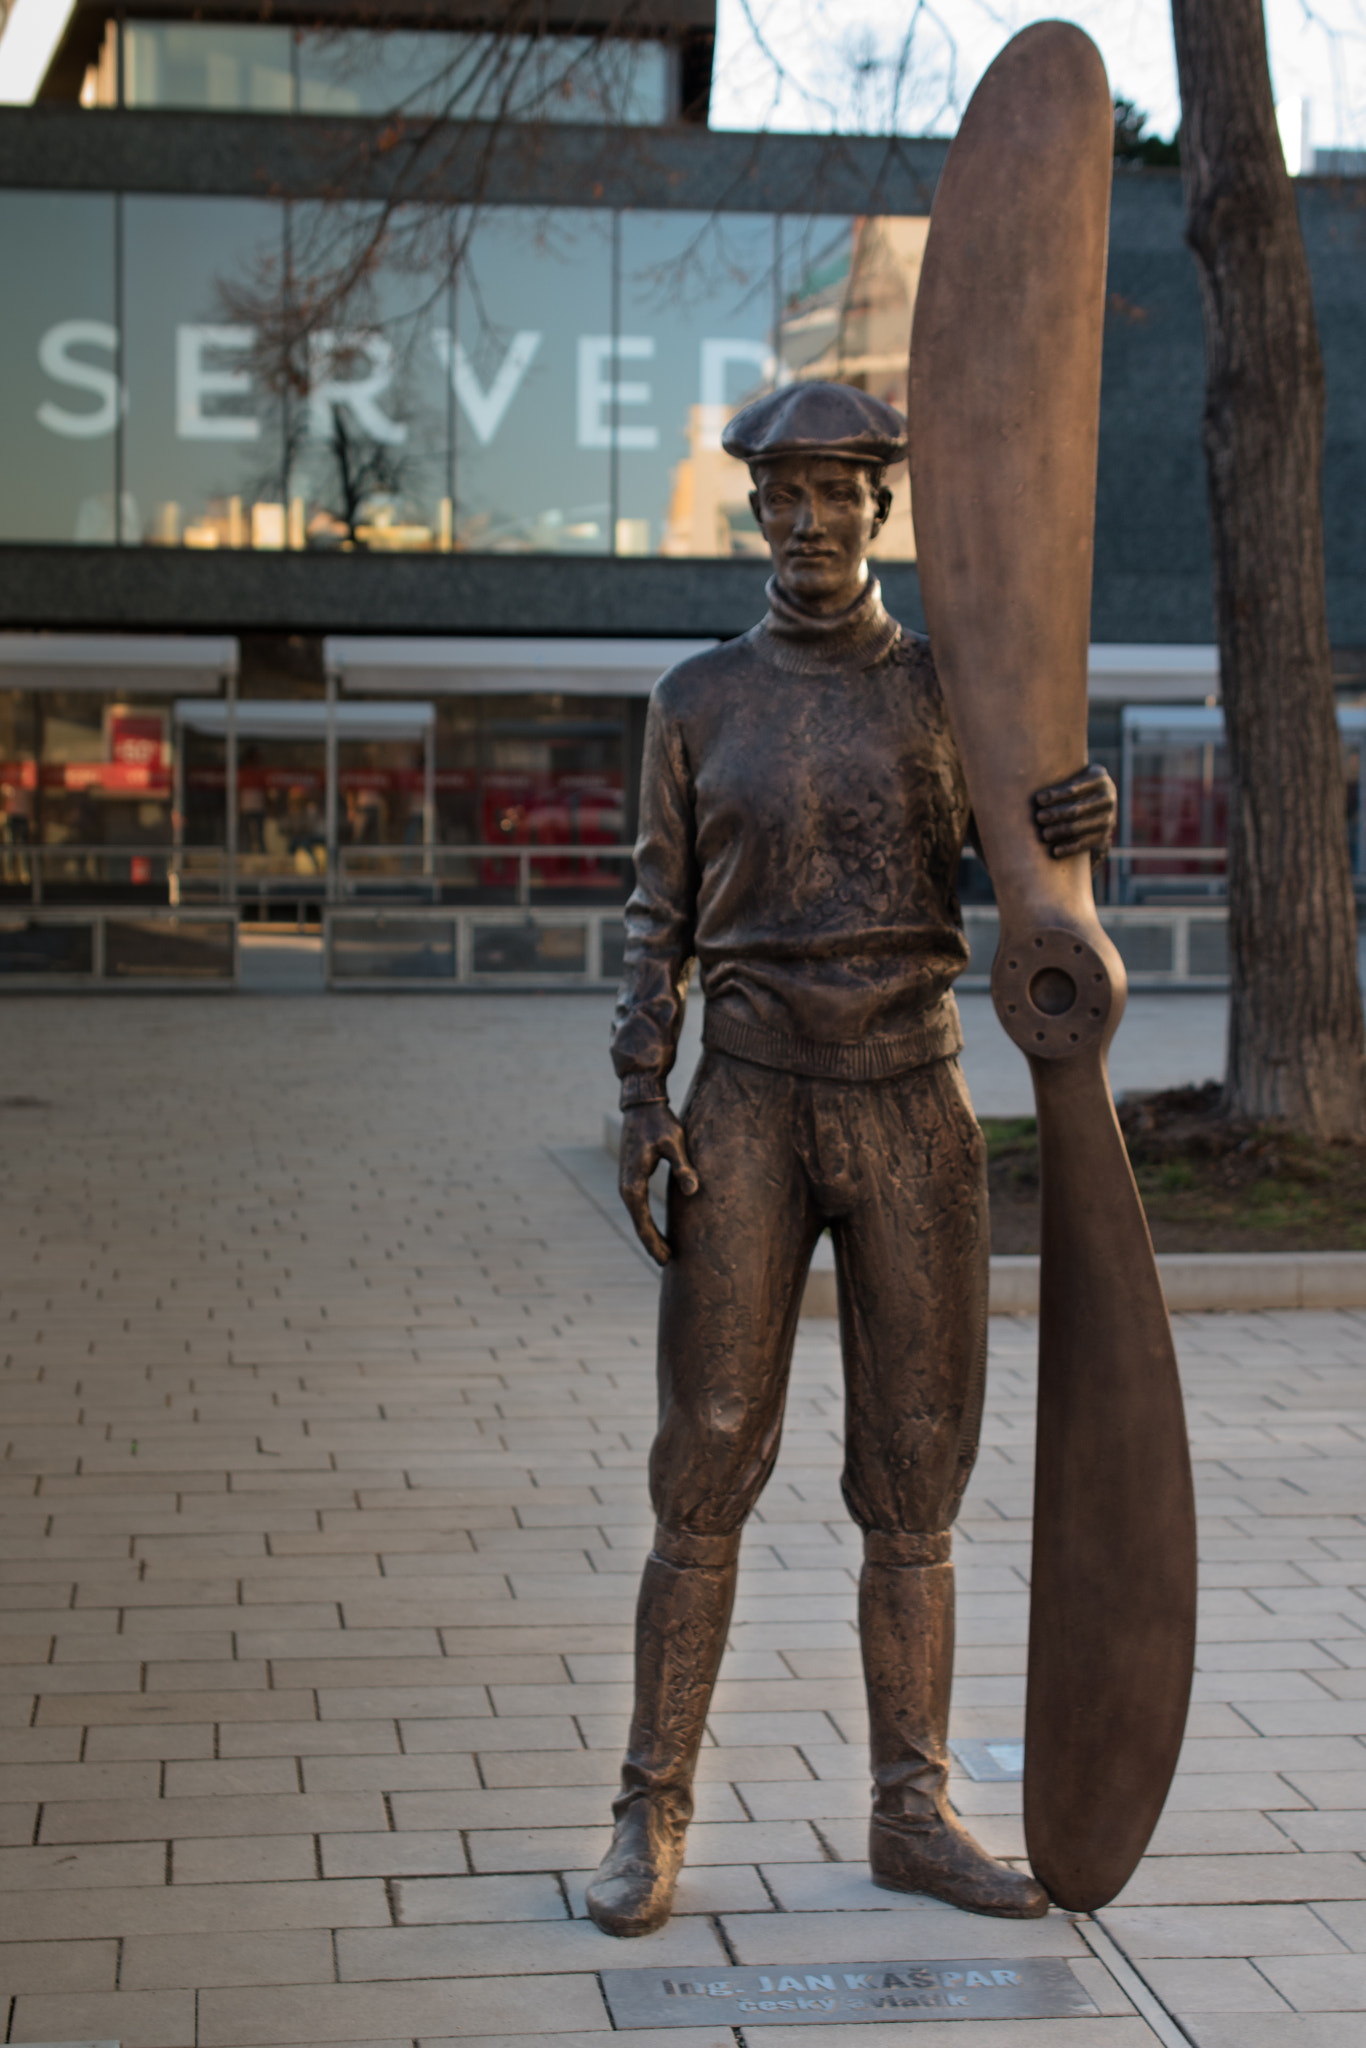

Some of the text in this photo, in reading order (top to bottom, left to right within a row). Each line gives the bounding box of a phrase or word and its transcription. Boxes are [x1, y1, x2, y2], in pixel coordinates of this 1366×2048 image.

[662, 1967, 1022, 1997] Ing. JAN KAŠPAR
[737, 1992, 971, 2013] český aviatik
